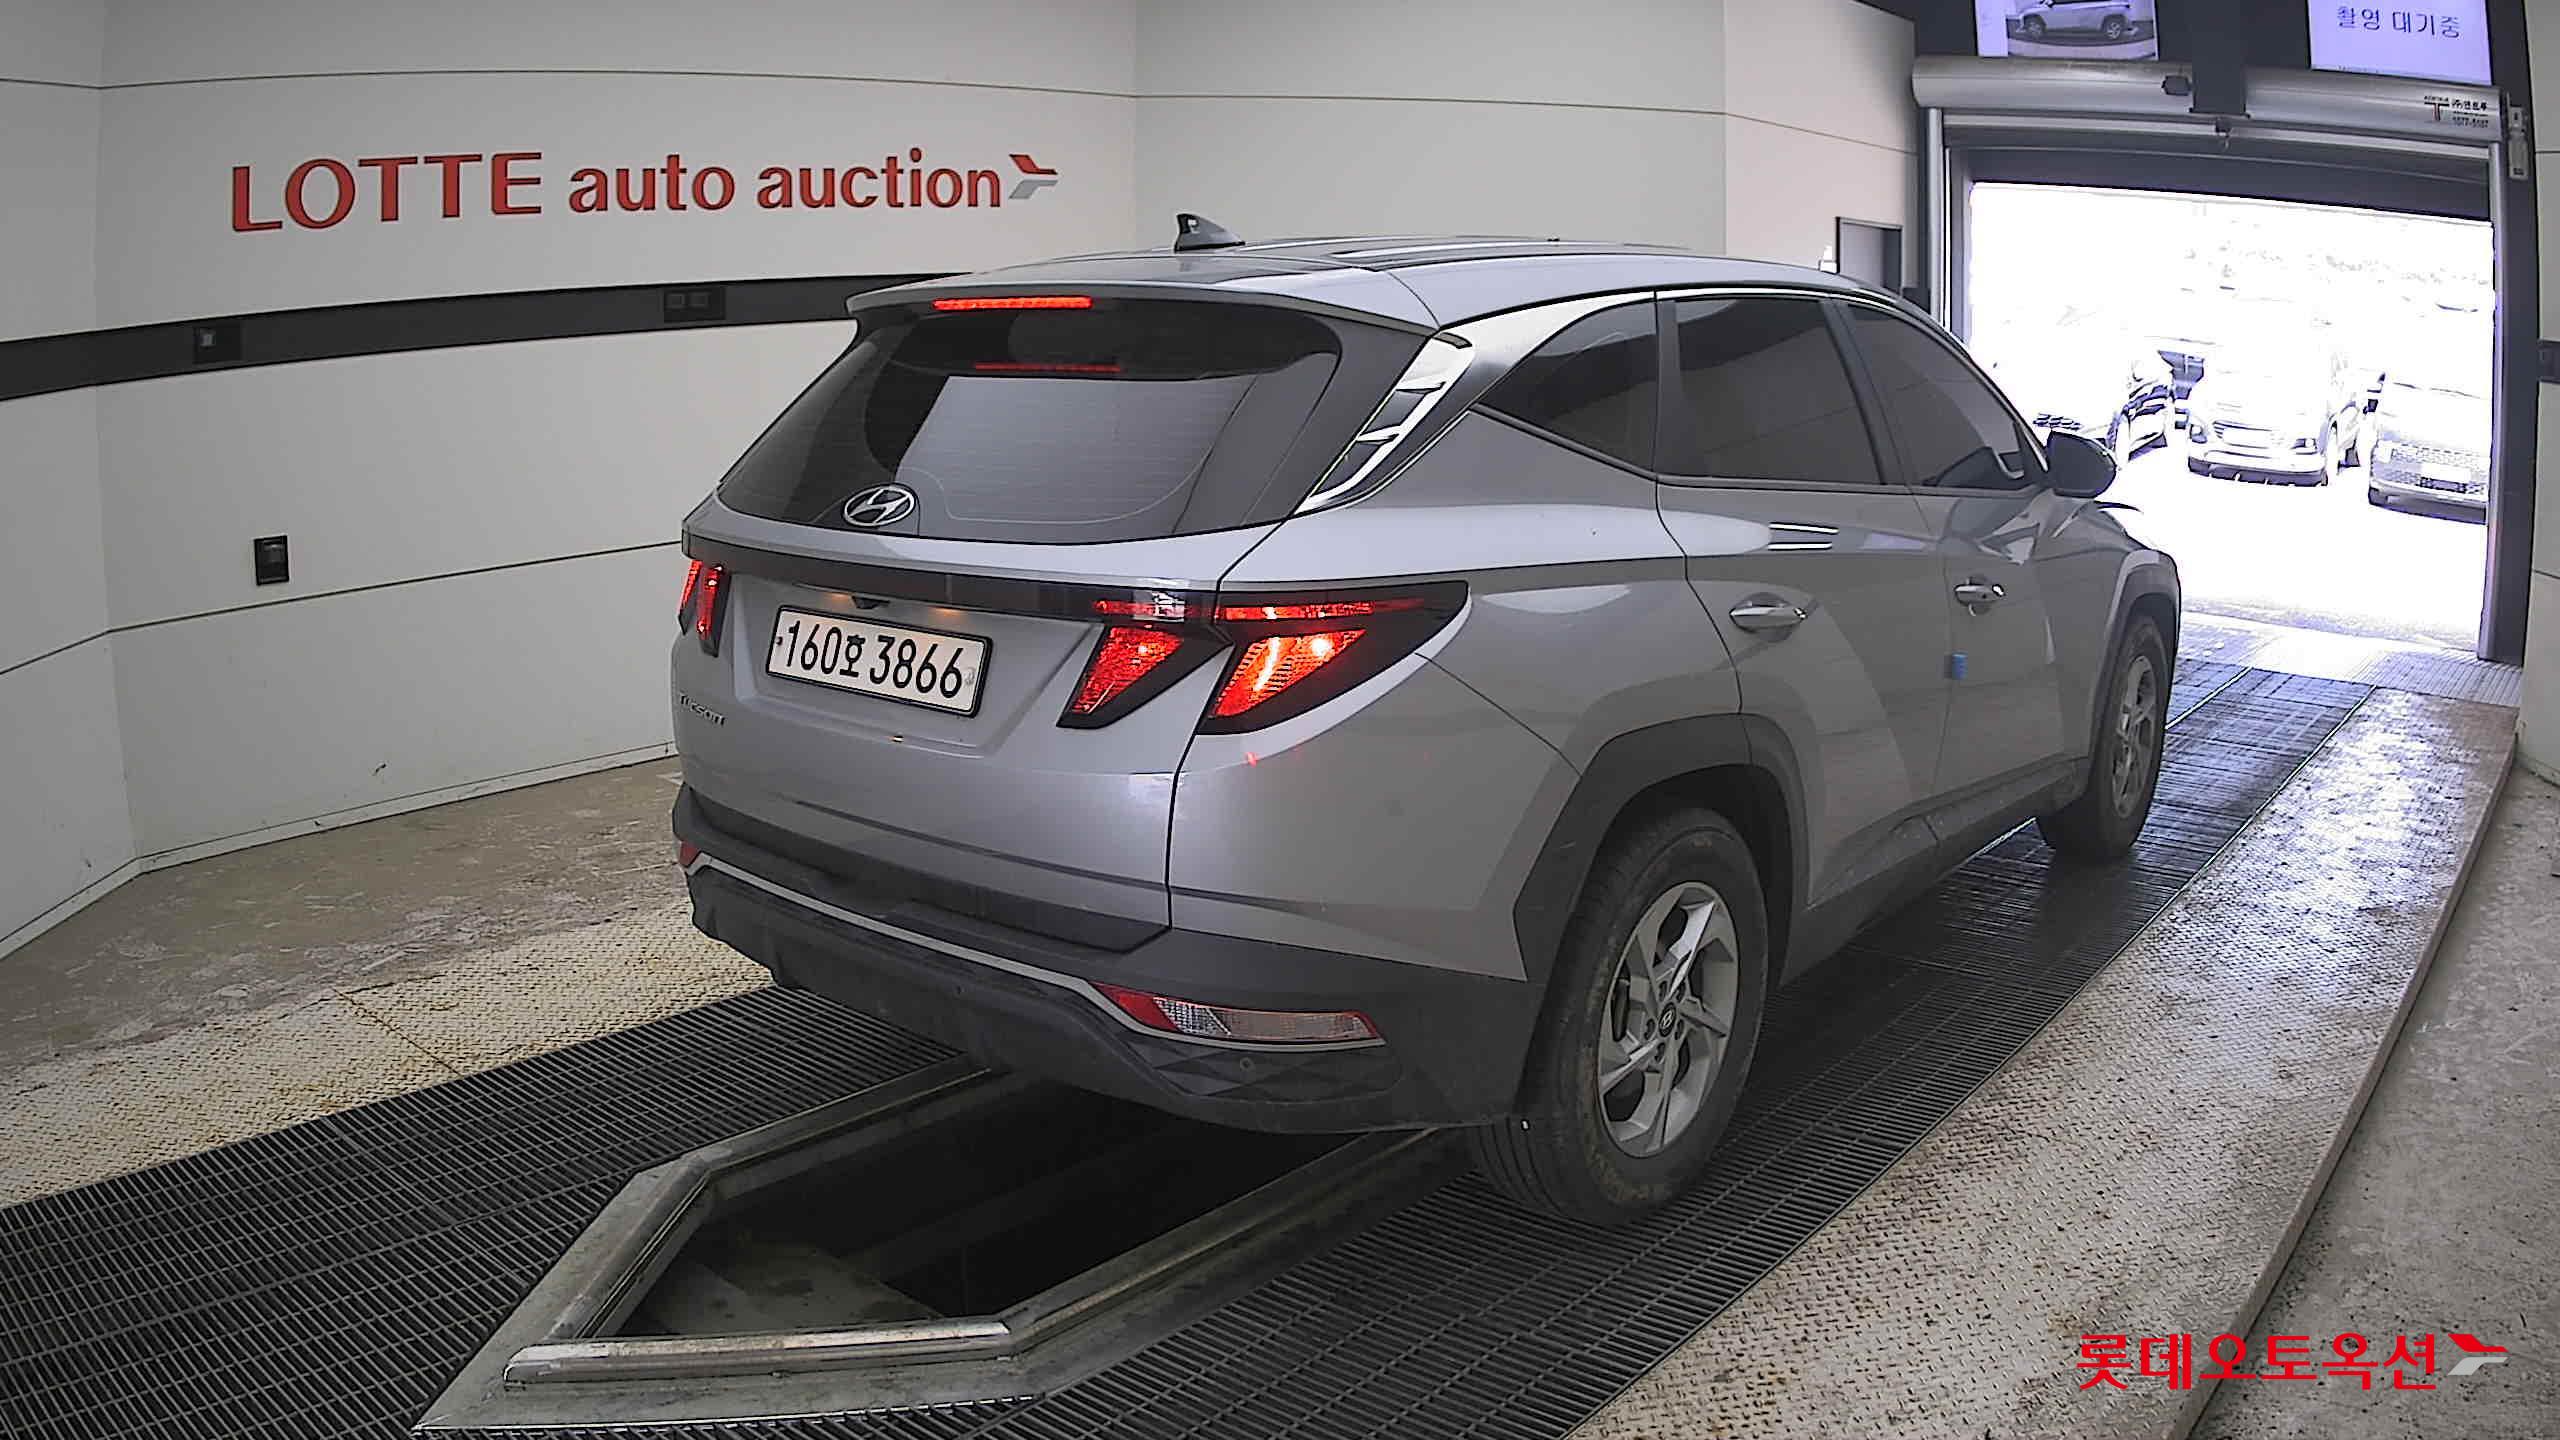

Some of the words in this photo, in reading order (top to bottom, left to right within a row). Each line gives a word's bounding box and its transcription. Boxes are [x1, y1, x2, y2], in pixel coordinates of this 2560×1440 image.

[2338, 6, 2380, 30] 촬영
[2392, 11, 2460, 38] 대기중
[233, 151, 542, 233] LOTTE
[569, 154, 737, 213] auto
[757, 148, 1003, 208] auction
[786, 620, 866, 679] 160호
[868, 634, 964, 699] 3866
